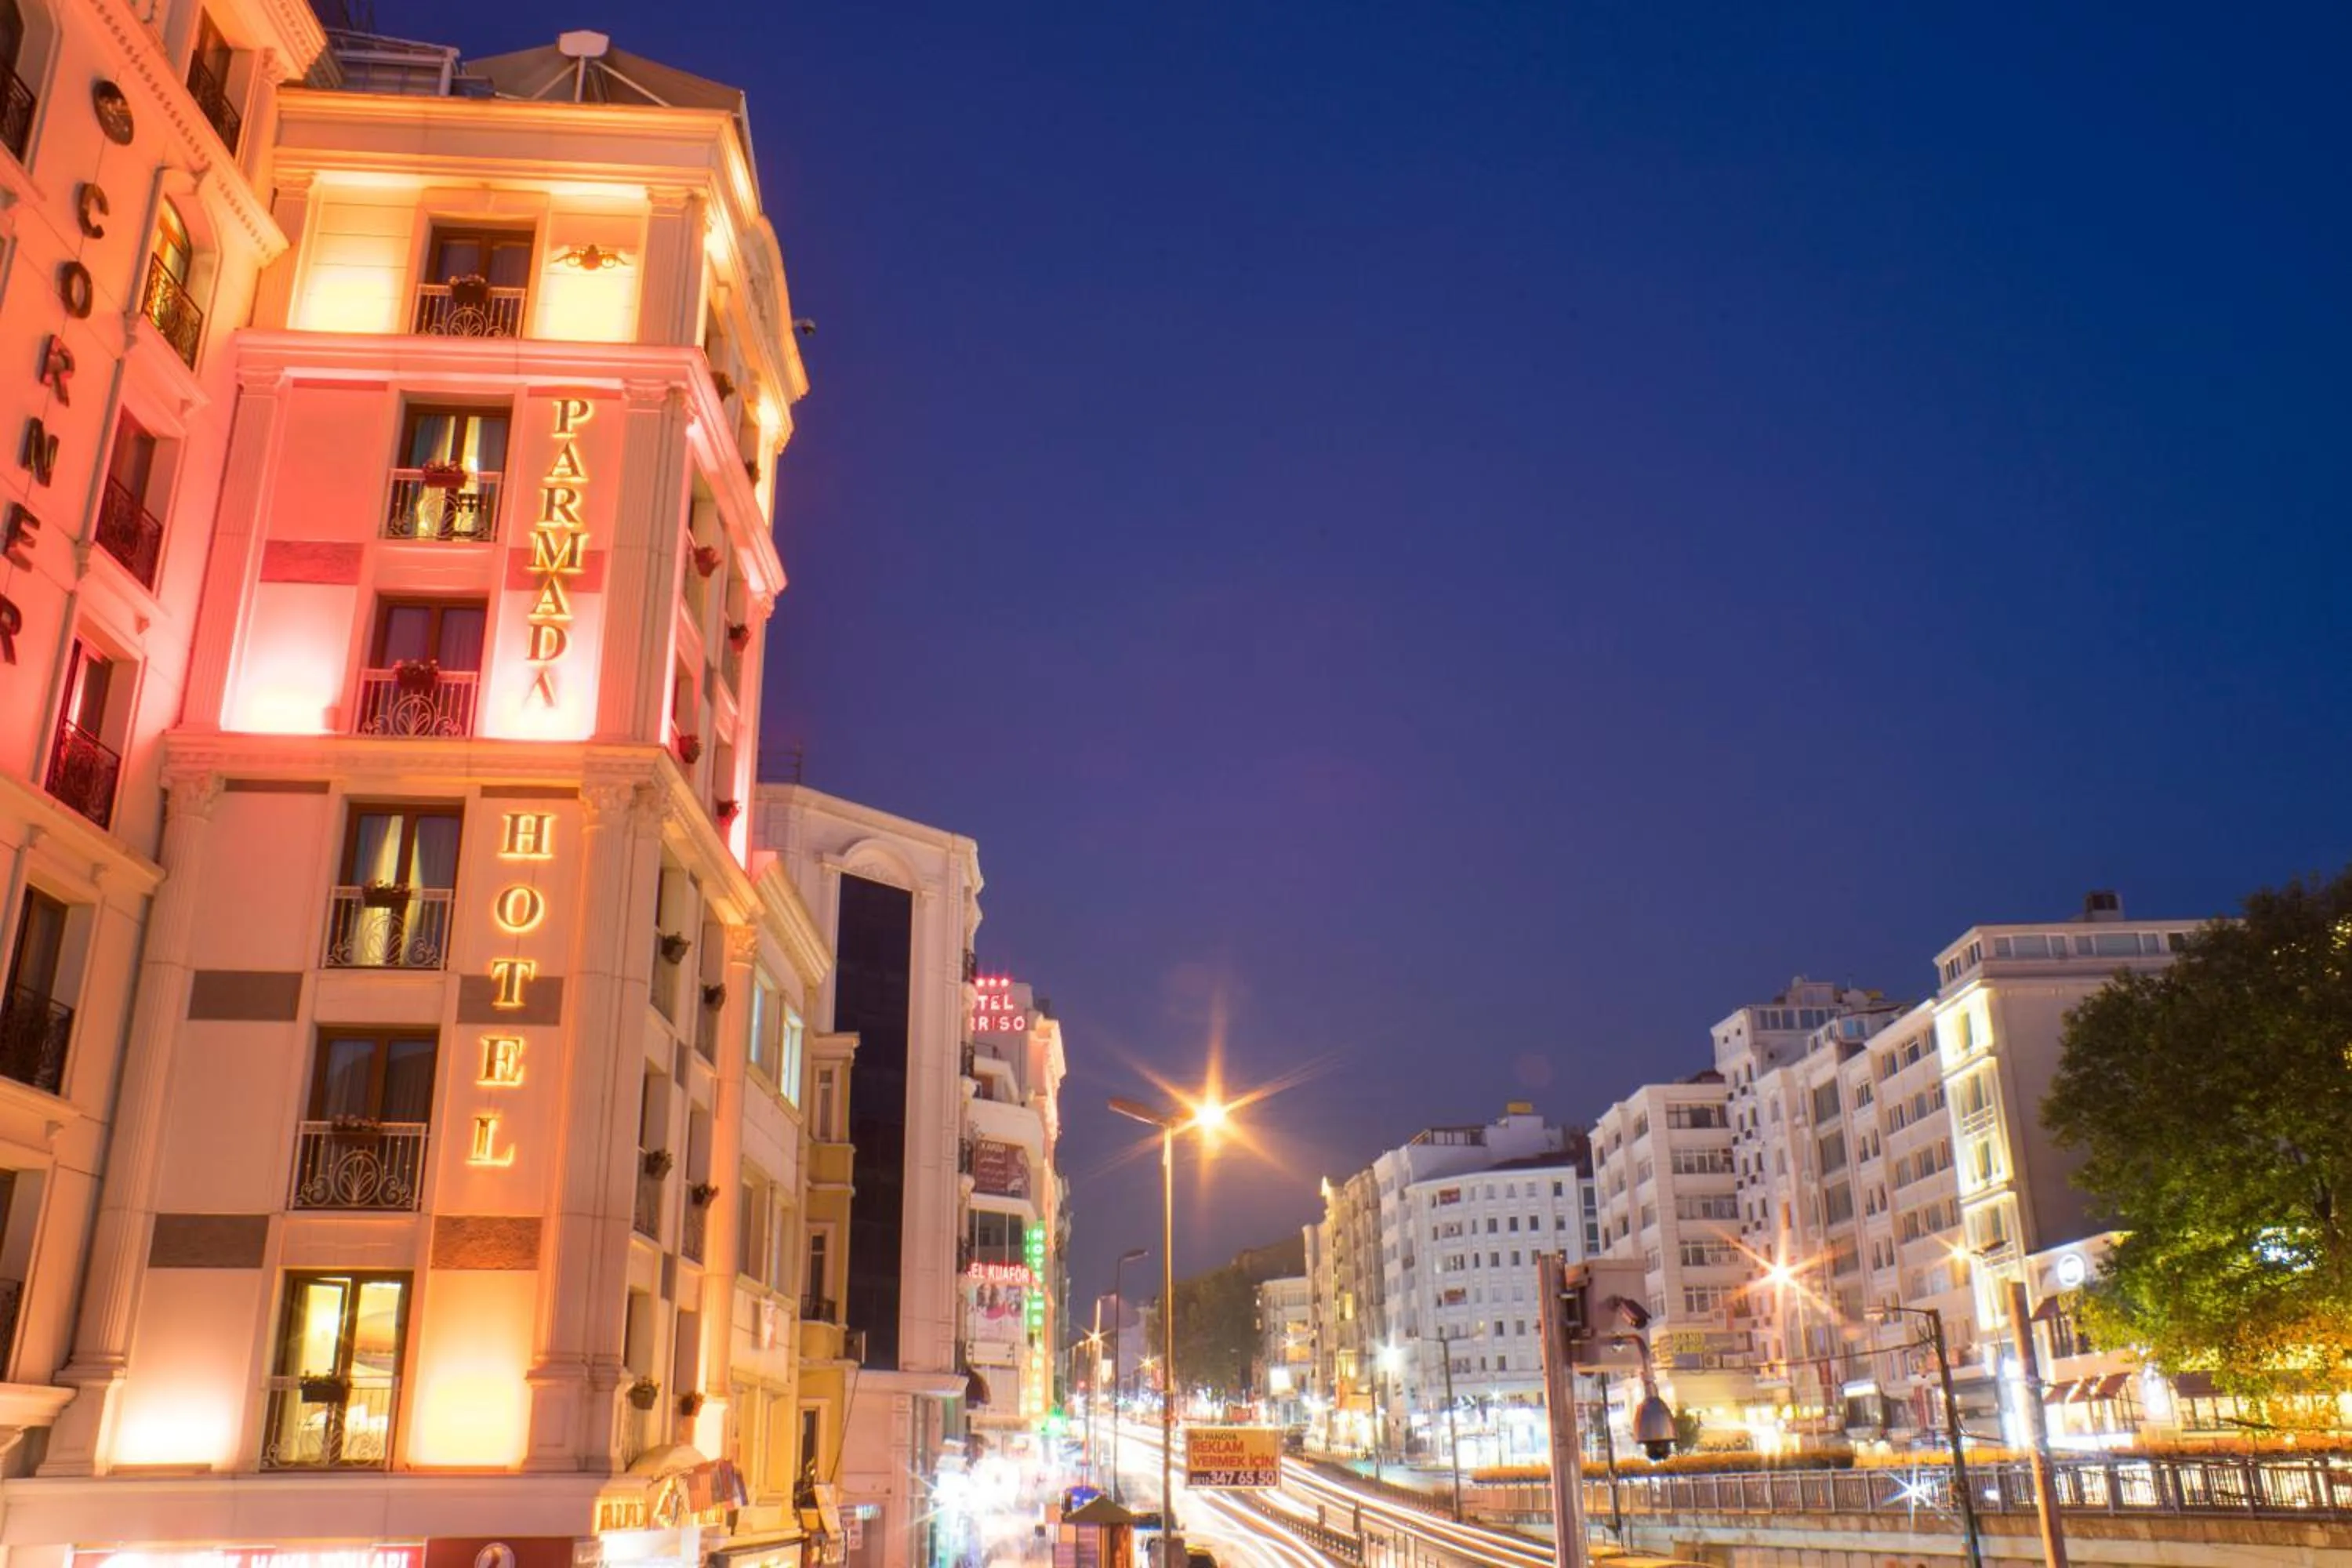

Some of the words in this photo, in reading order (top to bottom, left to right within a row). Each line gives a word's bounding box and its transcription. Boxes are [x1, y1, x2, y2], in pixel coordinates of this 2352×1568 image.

[0, 181, 110, 666] CORNER
[526, 398, 593, 708] PARMADA
[466, 812, 554, 1167] HOTEL
[975, 994, 1014, 1011] TEL
[967, 1262, 985, 1278] EL
[1192, 1441, 1244, 1454] REKLAM
[1192, 1455, 1245, 1468] VERMEK
[1249, 1453, 1275, 1471] İÇİN
[1210, 1470, 1235, 1485] 347
[1238, 1470, 1254, 1485] 65
[1258, 1470, 1275, 1486] 50
